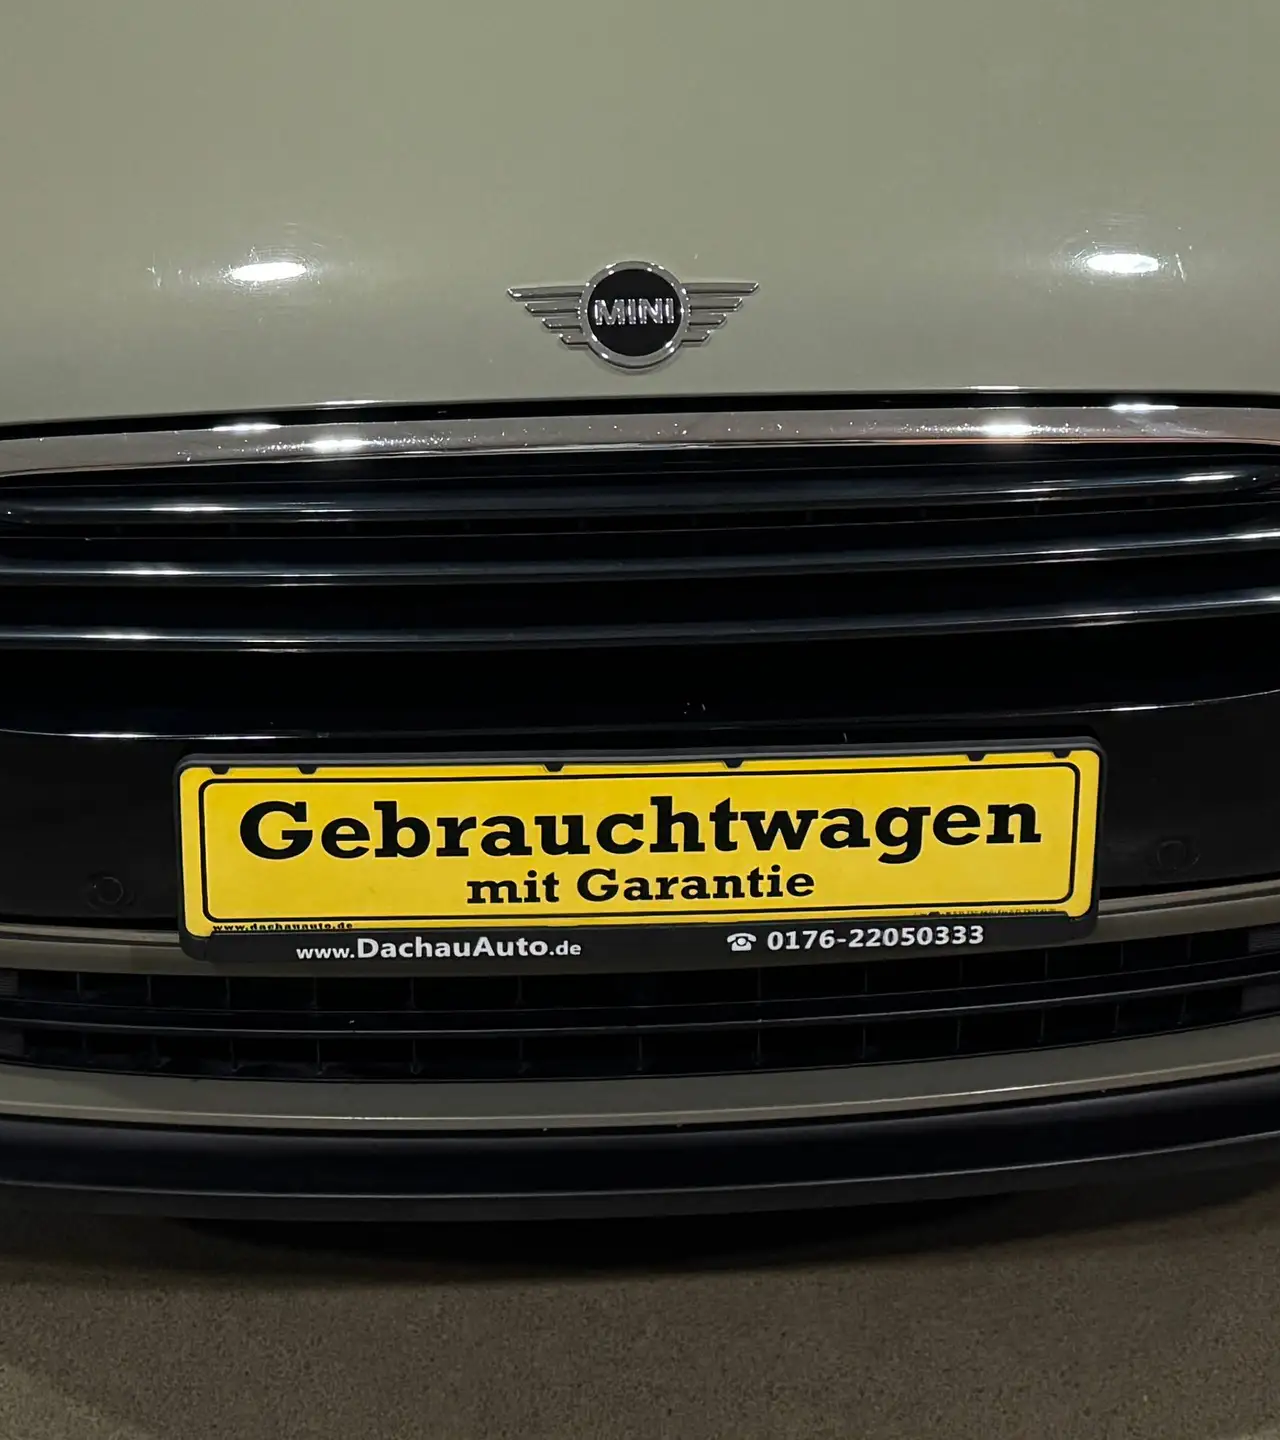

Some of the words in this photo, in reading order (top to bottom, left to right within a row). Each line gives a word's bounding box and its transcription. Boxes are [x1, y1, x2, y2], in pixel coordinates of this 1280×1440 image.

[594, 298, 674, 326] MINI
[239, 795, 1042, 865] Gebrauchtwagen
[467, 869, 560, 904] mit
[576, 864, 815, 903] Garantie
[296, 935, 582, 960] www.DachauAuto.de
[767, 924, 984, 951] 0176-22050333
